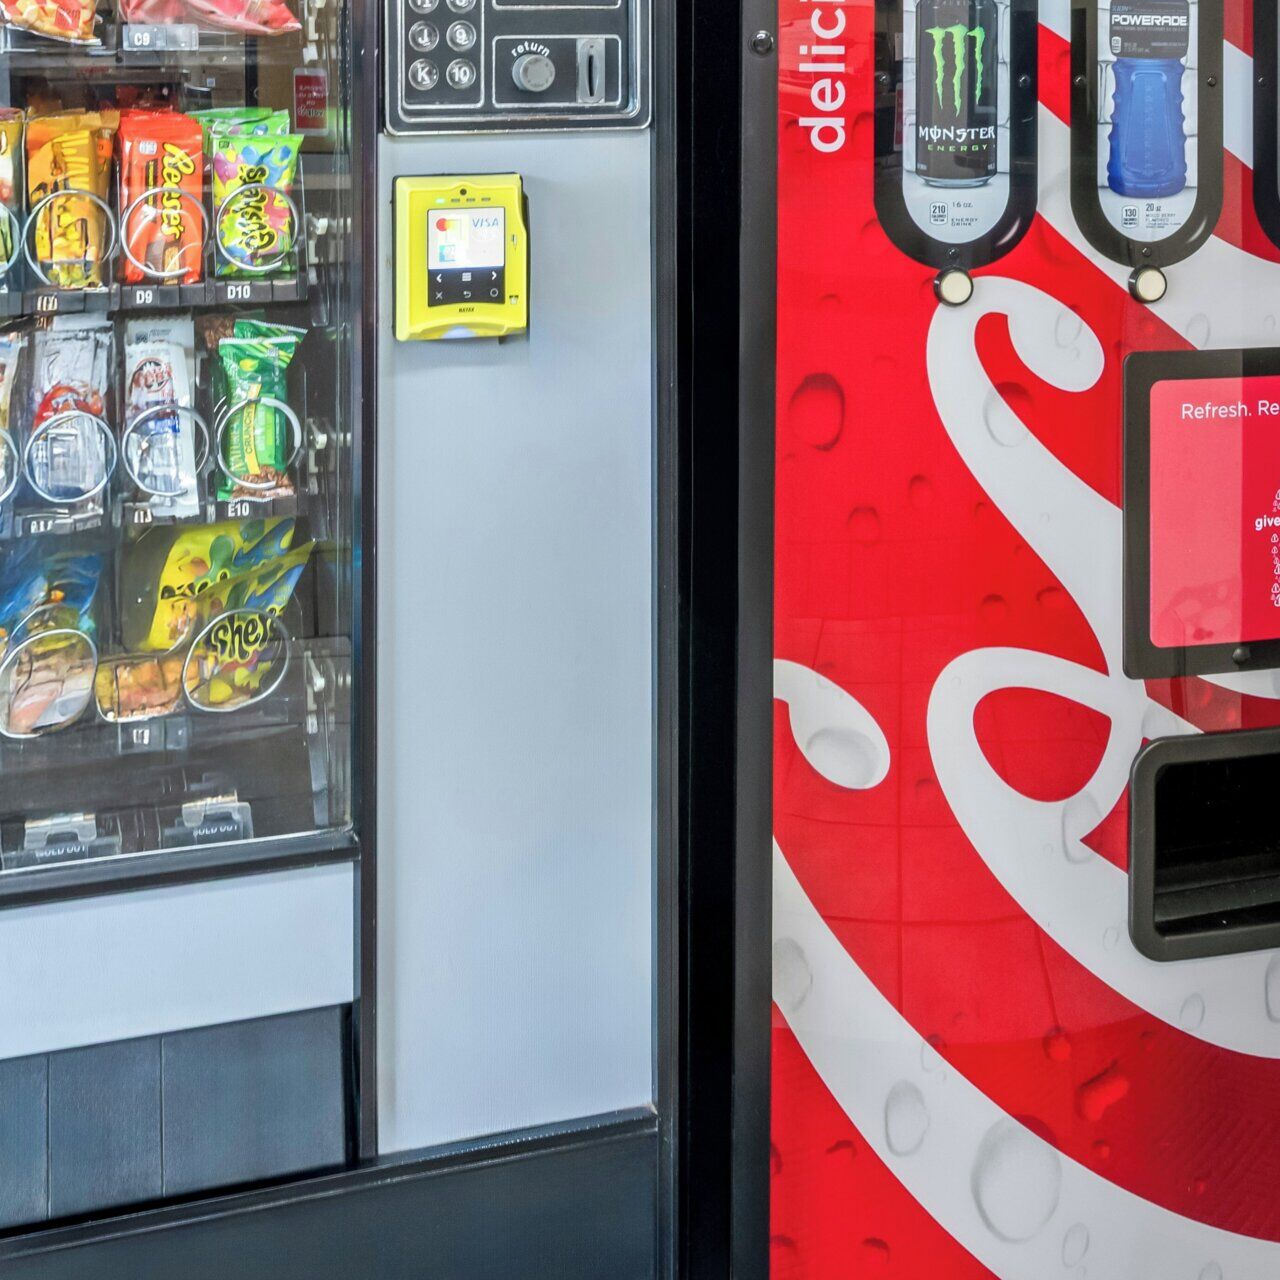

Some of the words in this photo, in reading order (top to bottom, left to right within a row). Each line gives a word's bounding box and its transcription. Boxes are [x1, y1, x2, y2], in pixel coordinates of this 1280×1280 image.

[1111, 14, 1188, 27] POWERADE
[454, 28, 468, 46] 9
[511, 41, 550, 57] return
[417, 67, 432, 85] K
[453, 66, 470, 82] 10
[927, 143, 988, 153] ENERGY
[931, 205, 947, 214] 210
[1124, 209, 1137, 218] 130
[1145, 203, 1155, 212] 20
[472, 217, 499, 228] VISA
[135, 289, 153, 304] D9
[227, 285, 251, 299] D10
[1181, 402, 1252, 420] Refresh.
[227, 502, 250, 517] E10
